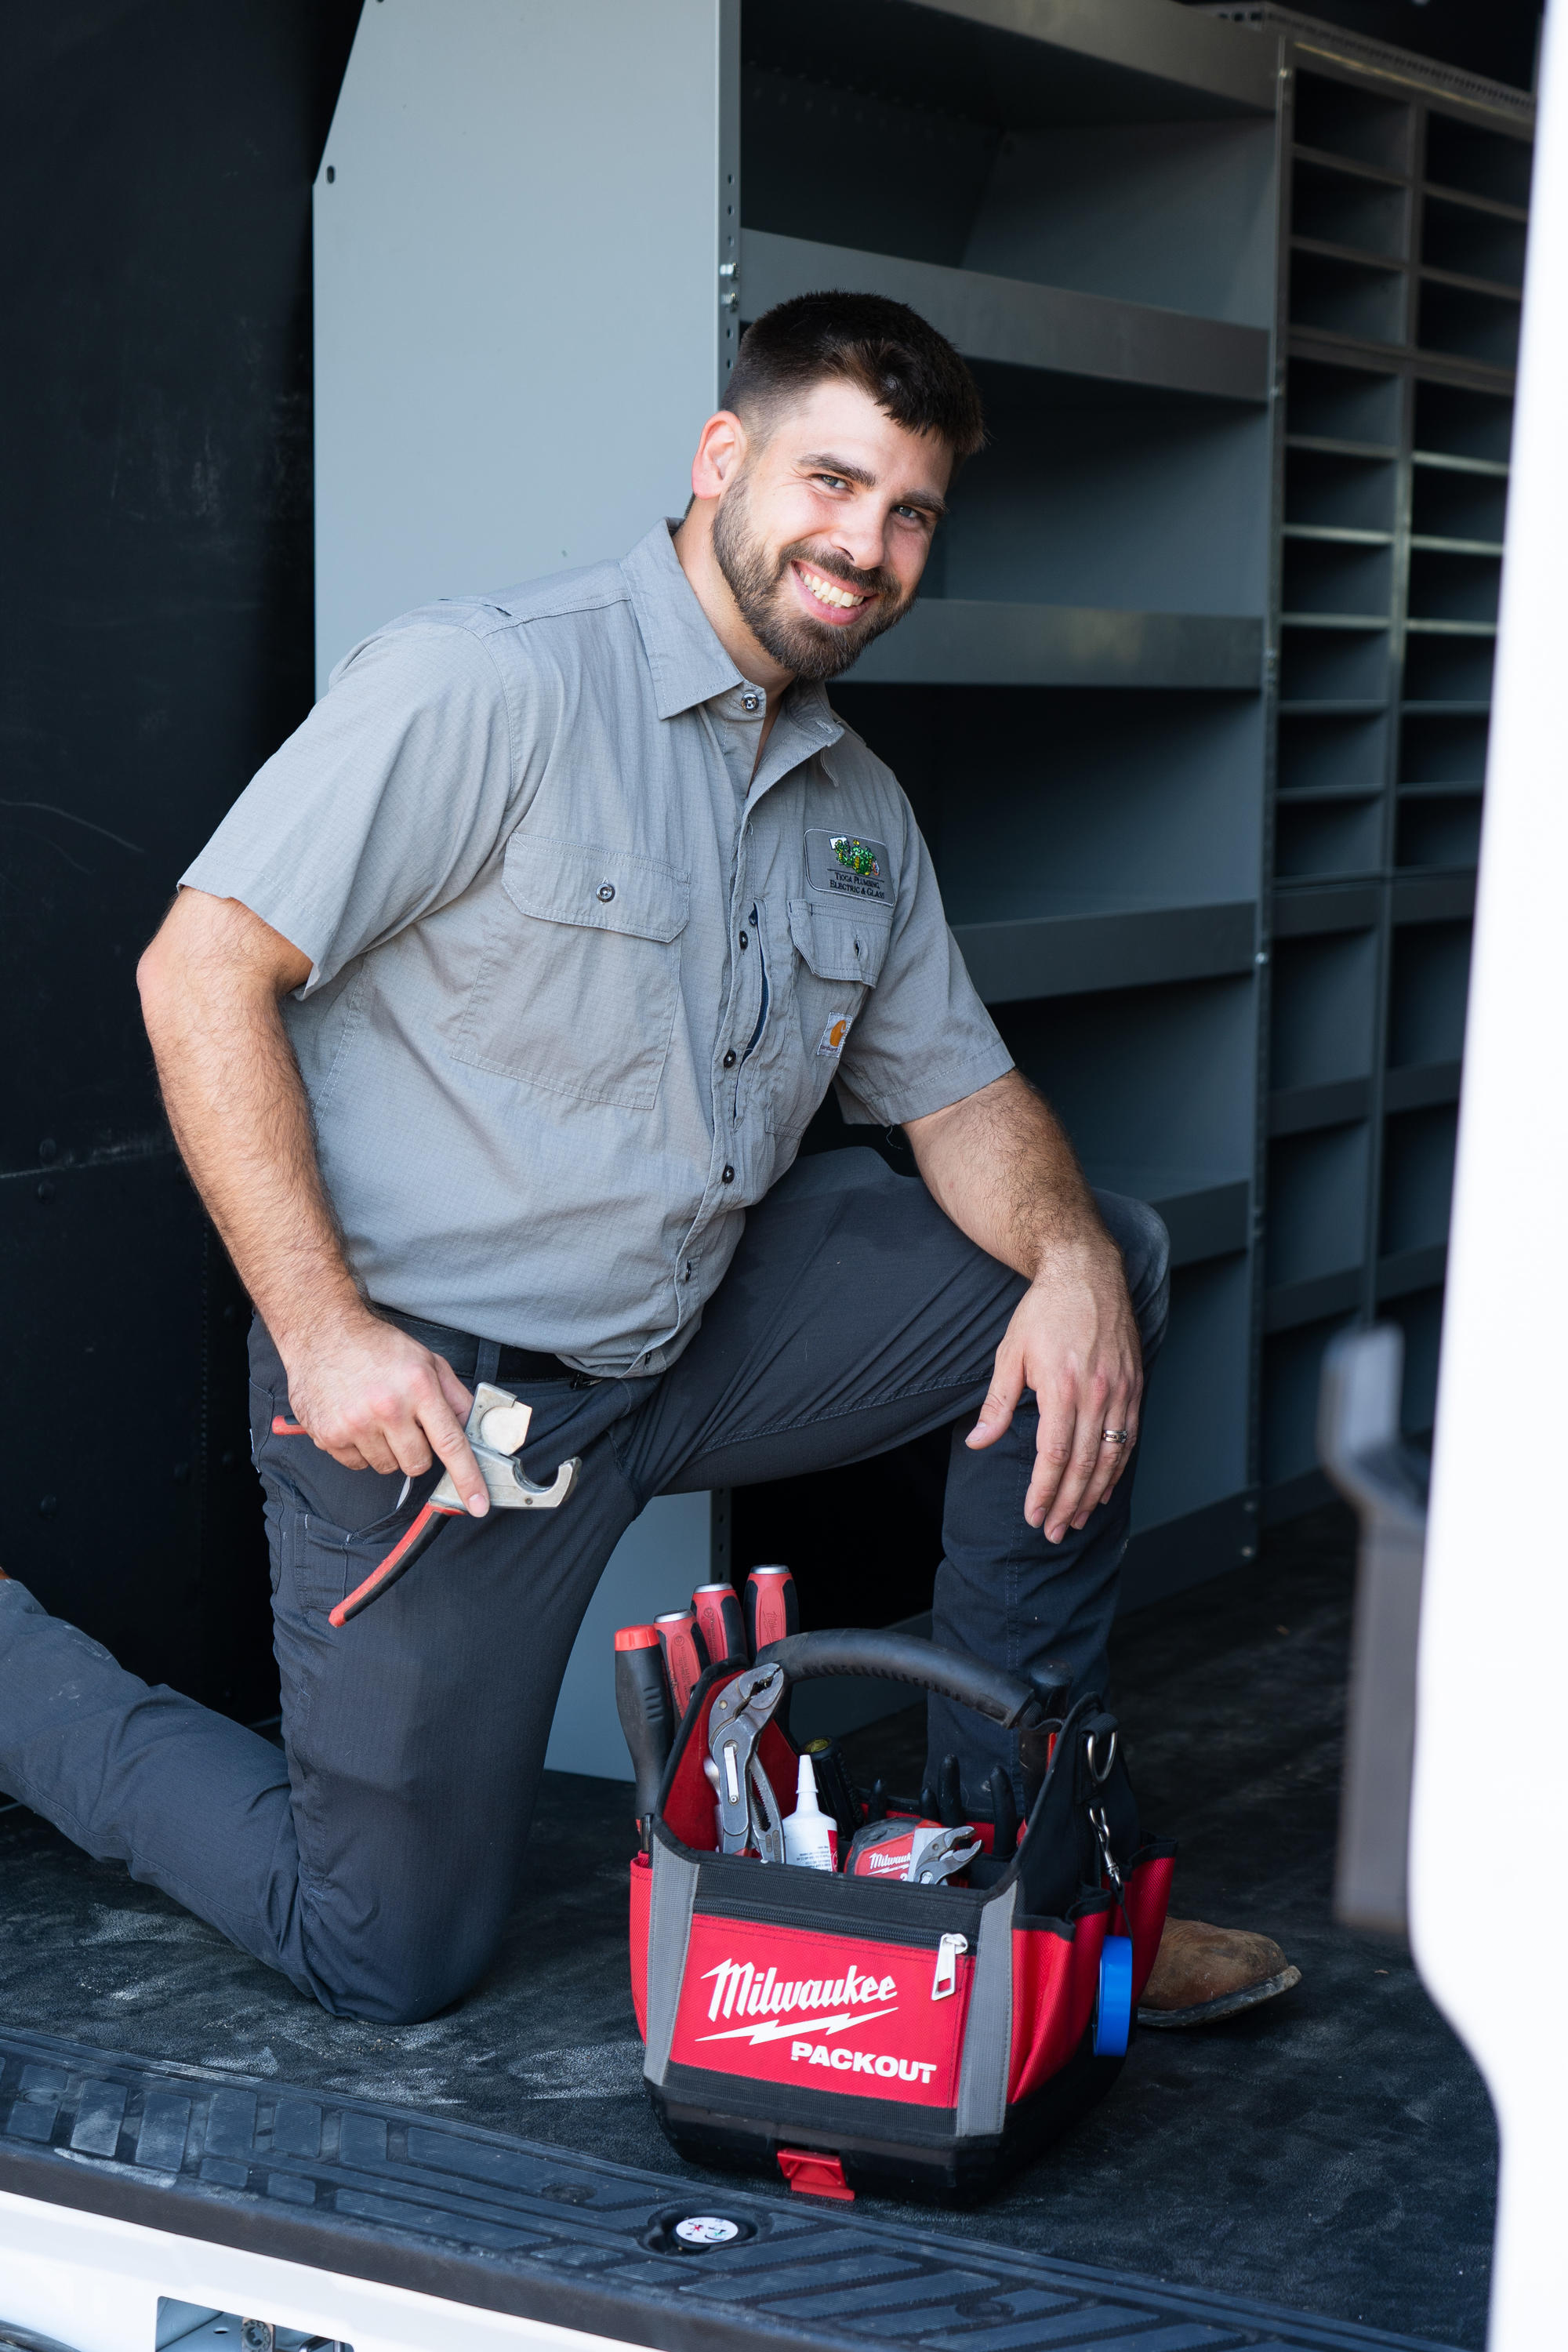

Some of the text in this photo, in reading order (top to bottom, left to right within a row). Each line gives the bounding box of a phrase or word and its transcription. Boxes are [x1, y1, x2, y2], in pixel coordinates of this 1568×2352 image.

[829, 880, 860, 893] ELECTRIC
[866, 888, 885, 898] GLASS
[869, 1852, 911, 1870] Milwauk
[700, 1958, 898, 2022] Milwaukee
[790, 2041, 937, 2084] PACKOUT
